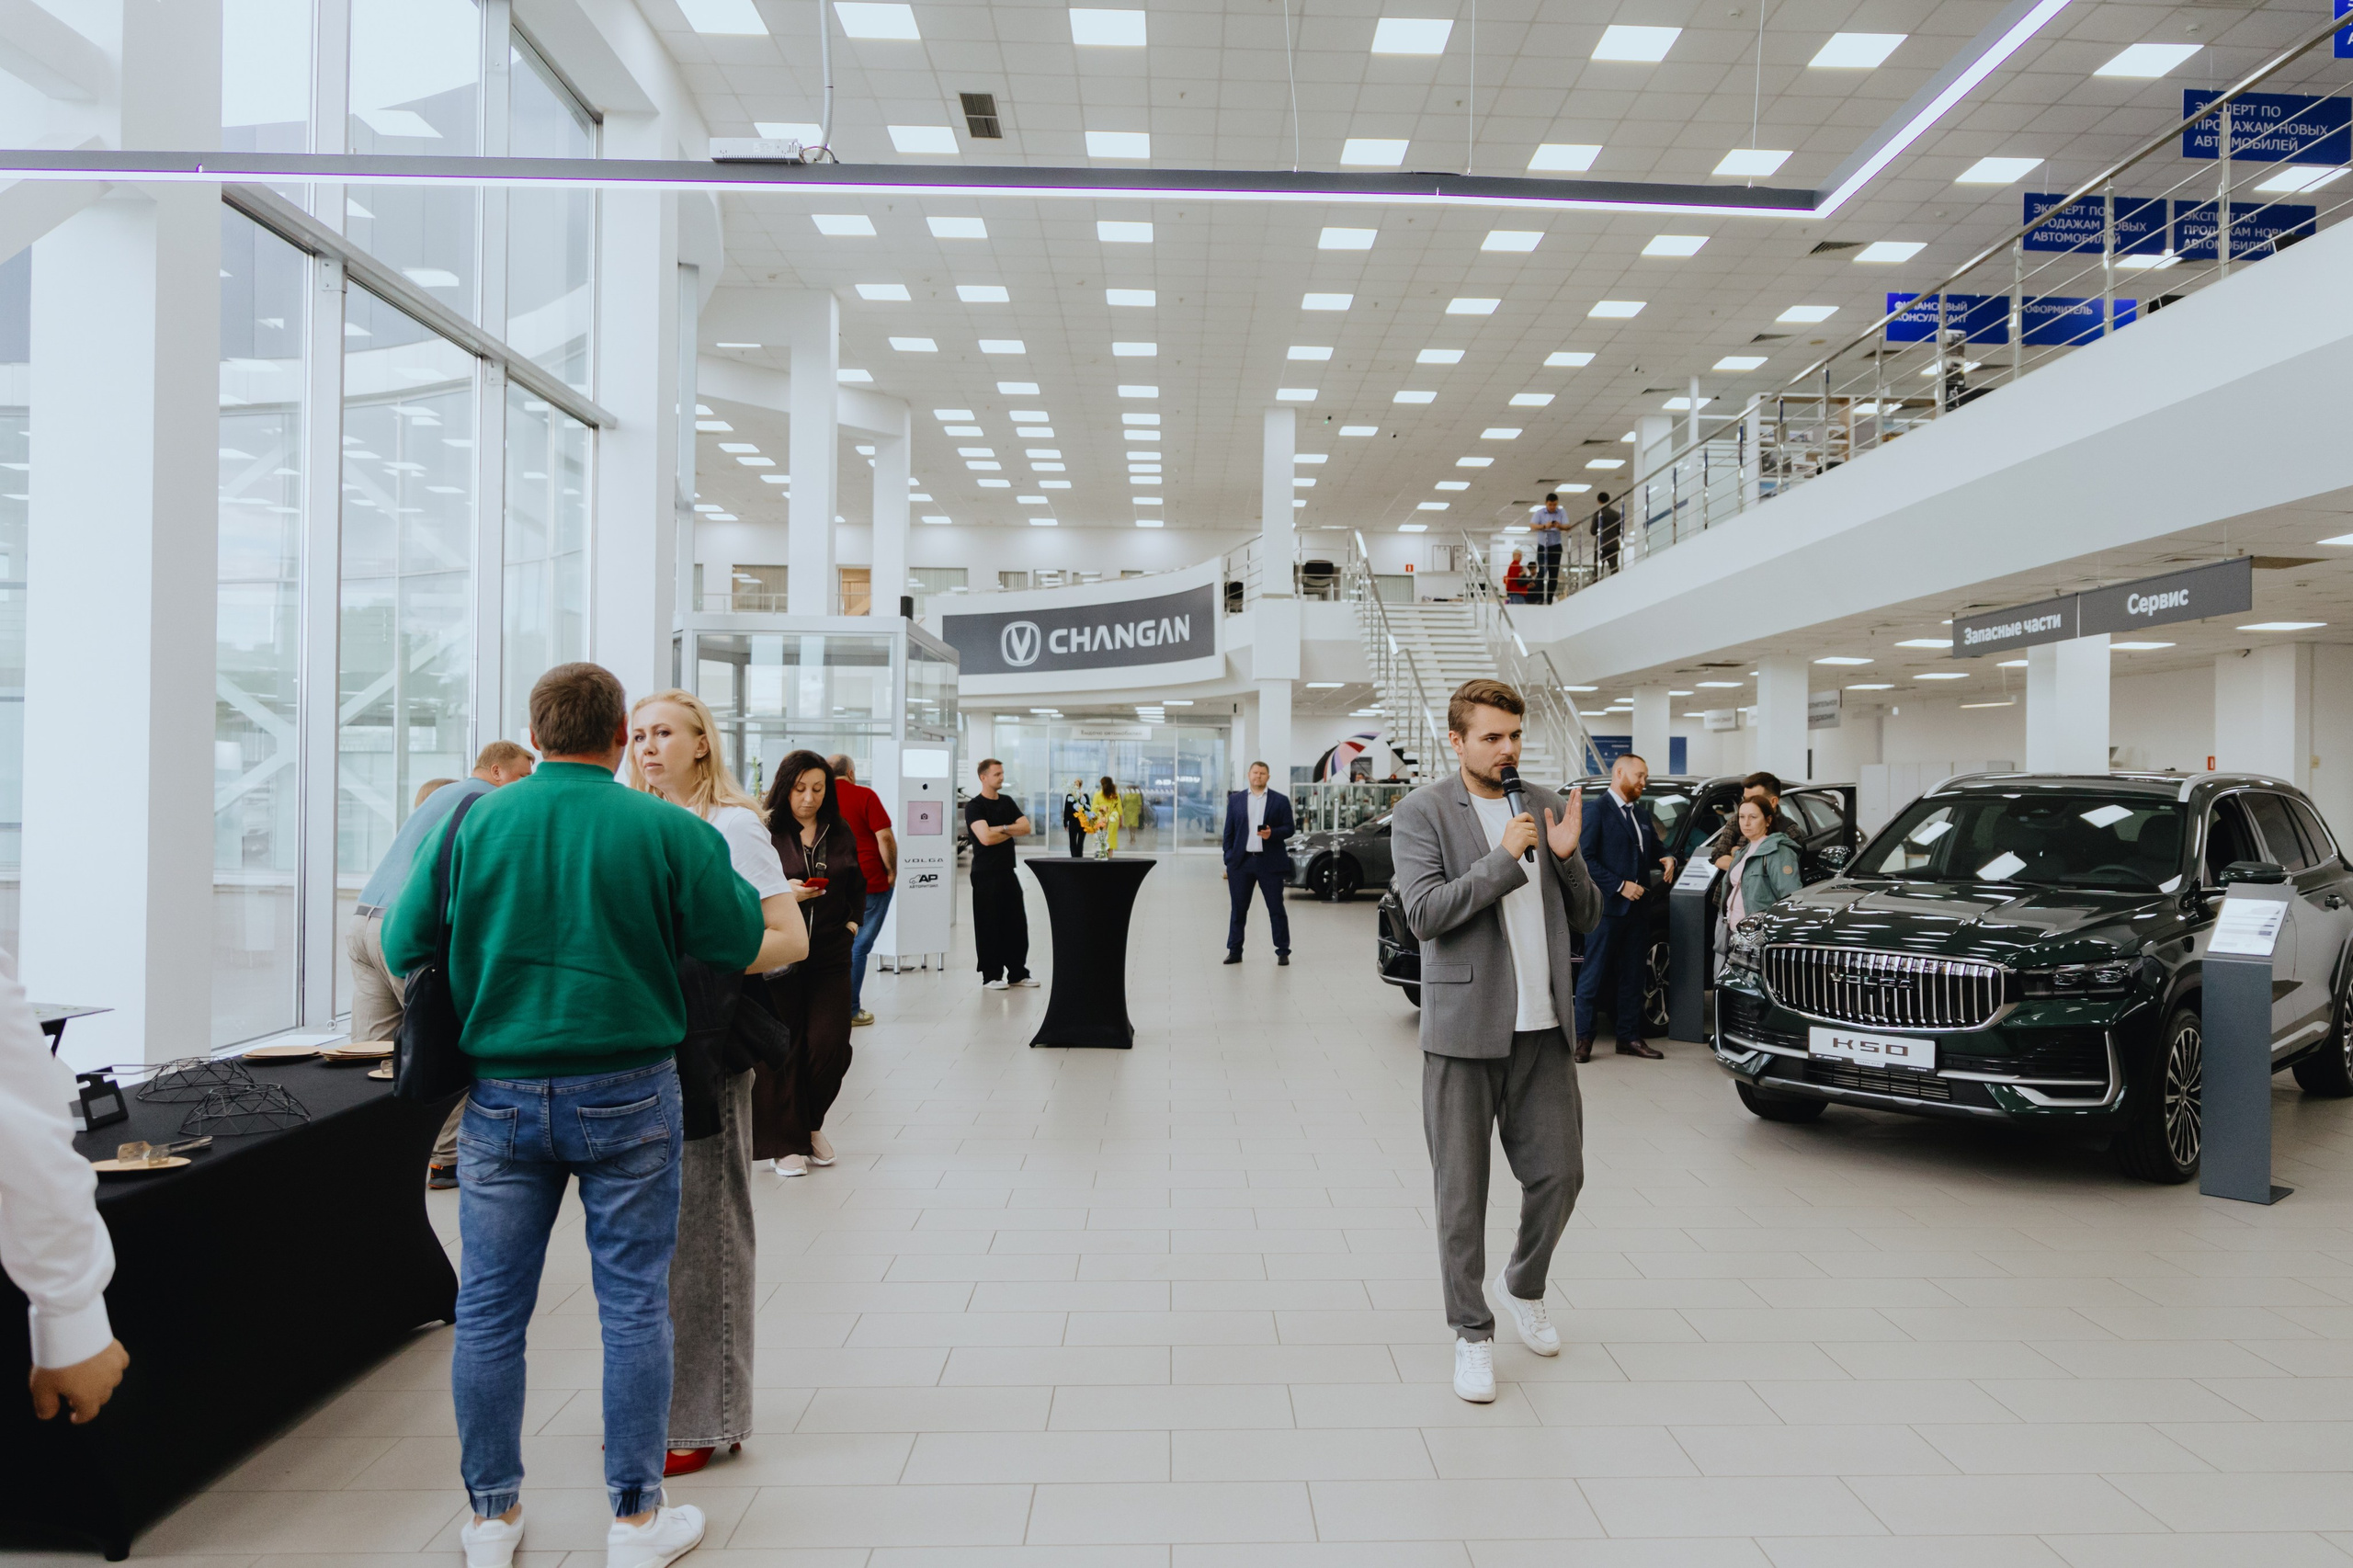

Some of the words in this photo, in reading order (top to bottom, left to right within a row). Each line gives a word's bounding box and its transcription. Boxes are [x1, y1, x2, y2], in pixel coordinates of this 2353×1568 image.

[2261, 106, 2281, 117] ПО
[2279, 123, 2328, 135] НОВЫХ
[2194, 135, 2298, 151] АВТМОБИЛЕЙ
[2033, 217, 2100, 230] РОДАЖАМ
[2113, 222, 2147, 232] ОВЫХ
[2032, 231, 2121, 245] АВТОМОБИЛЙ
[2127, 588, 2189, 617] Сервис
[1049, 614, 1190, 654] CHANGAN
[1963, 620, 2022, 645] Запасные
[2023, 613, 2062, 634] части
[1830, 972, 1914, 989] VOLGA
[1833, 1037, 1909, 1057] K50
